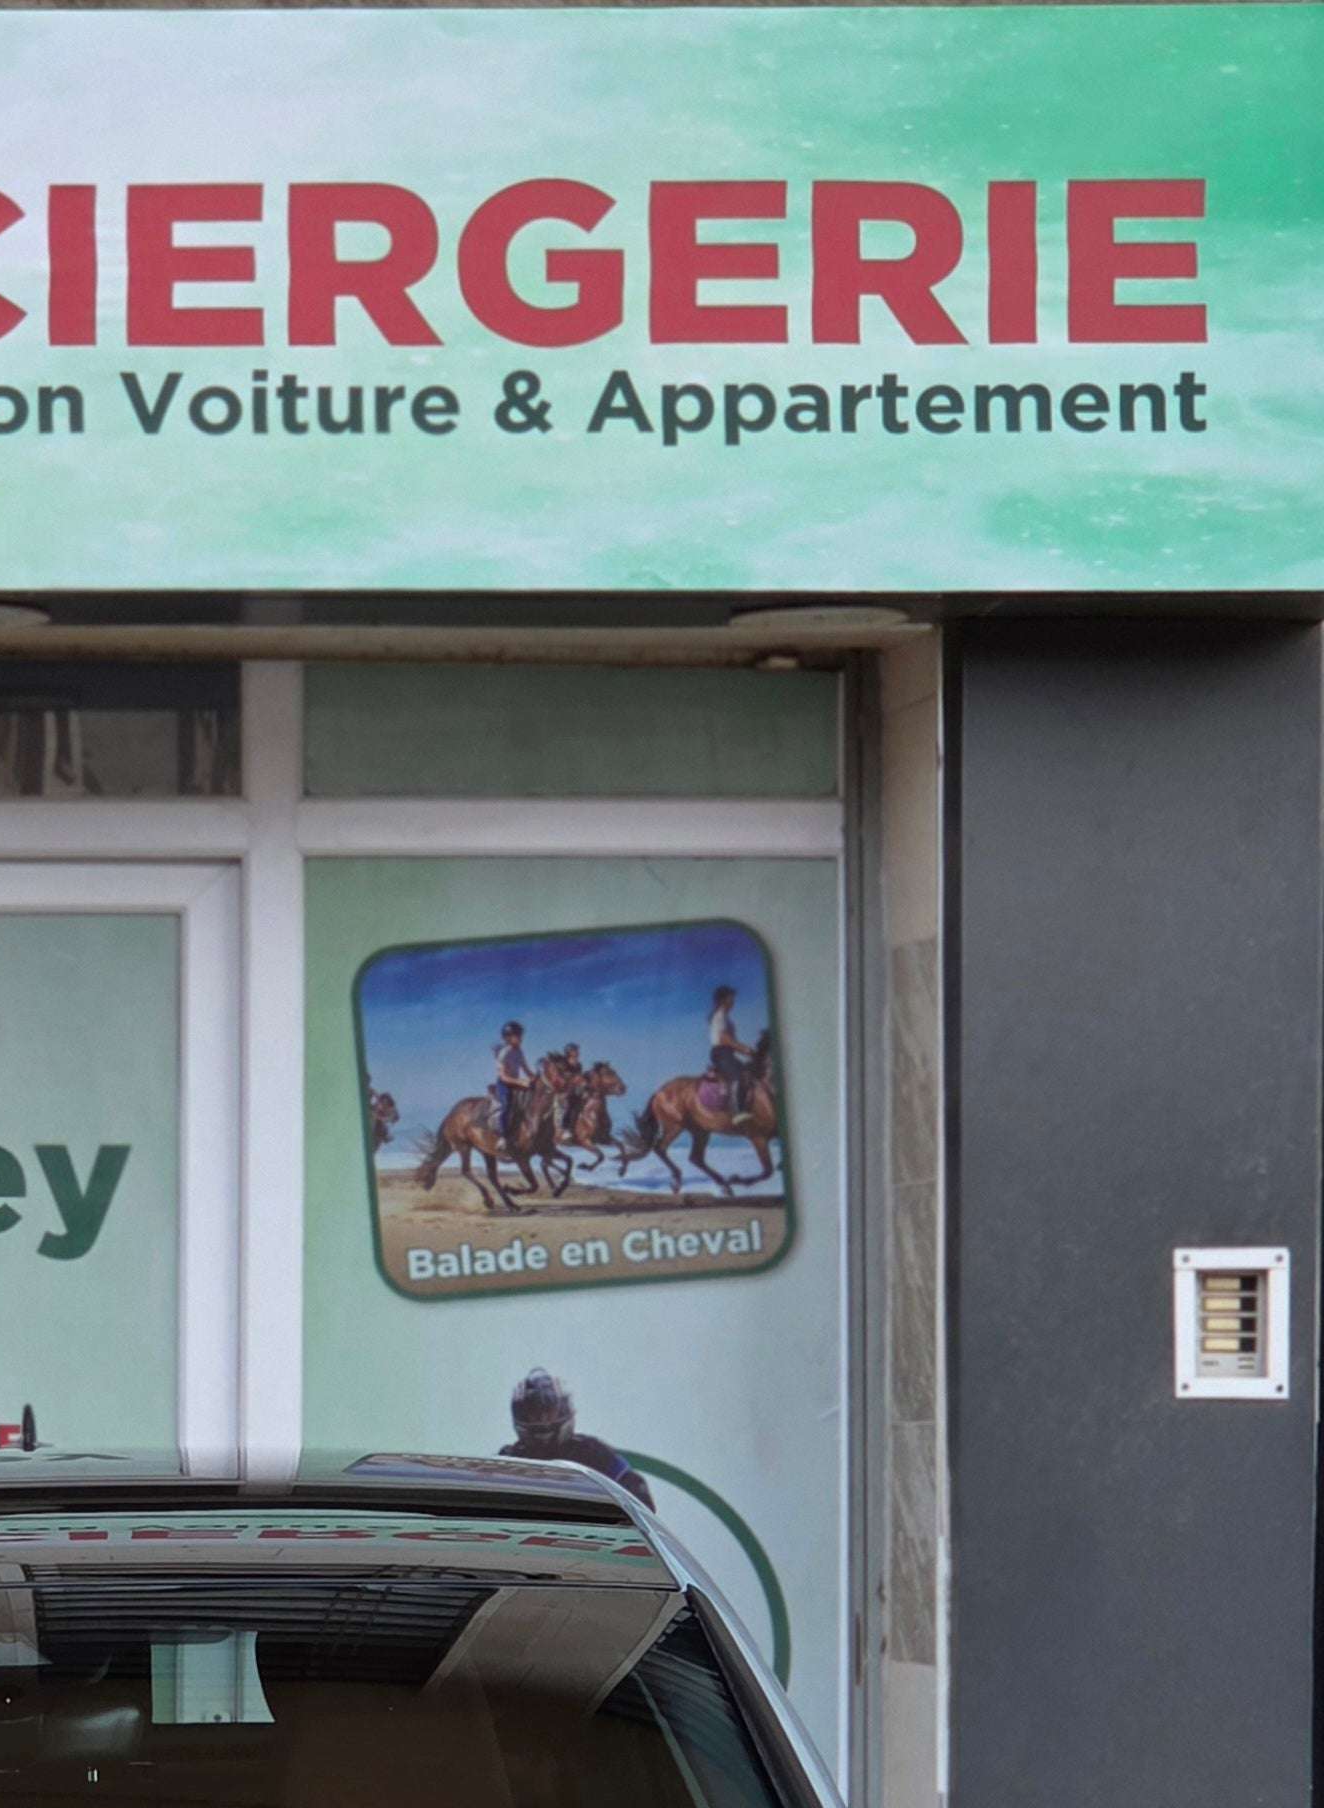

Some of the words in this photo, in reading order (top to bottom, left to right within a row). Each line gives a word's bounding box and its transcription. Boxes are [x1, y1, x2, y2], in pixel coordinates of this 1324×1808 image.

[120, 369, 461, 436] Voiture
[494, 369, 553, 434] &
[587, 370, 1207, 447] Appartement
[407, 1238, 549, 1281] Balade
[560, 1238, 611, 1268] en
[621, 1219, 763, 1263] Cheval
